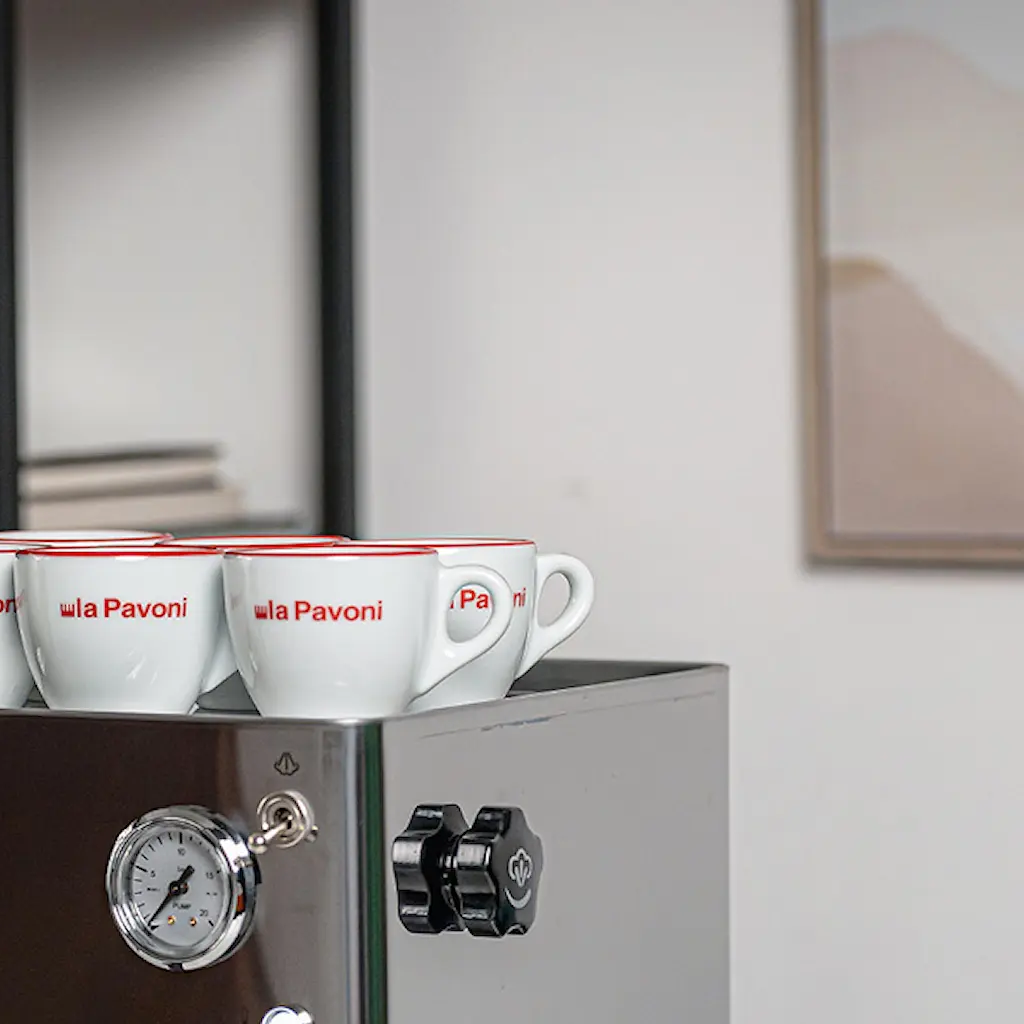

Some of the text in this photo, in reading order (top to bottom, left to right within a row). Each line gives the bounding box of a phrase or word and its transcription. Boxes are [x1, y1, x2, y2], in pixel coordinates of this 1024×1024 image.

[76, 597, 187, 618] la Pavoni
[268, 599, 382, 621] la Pavoni
